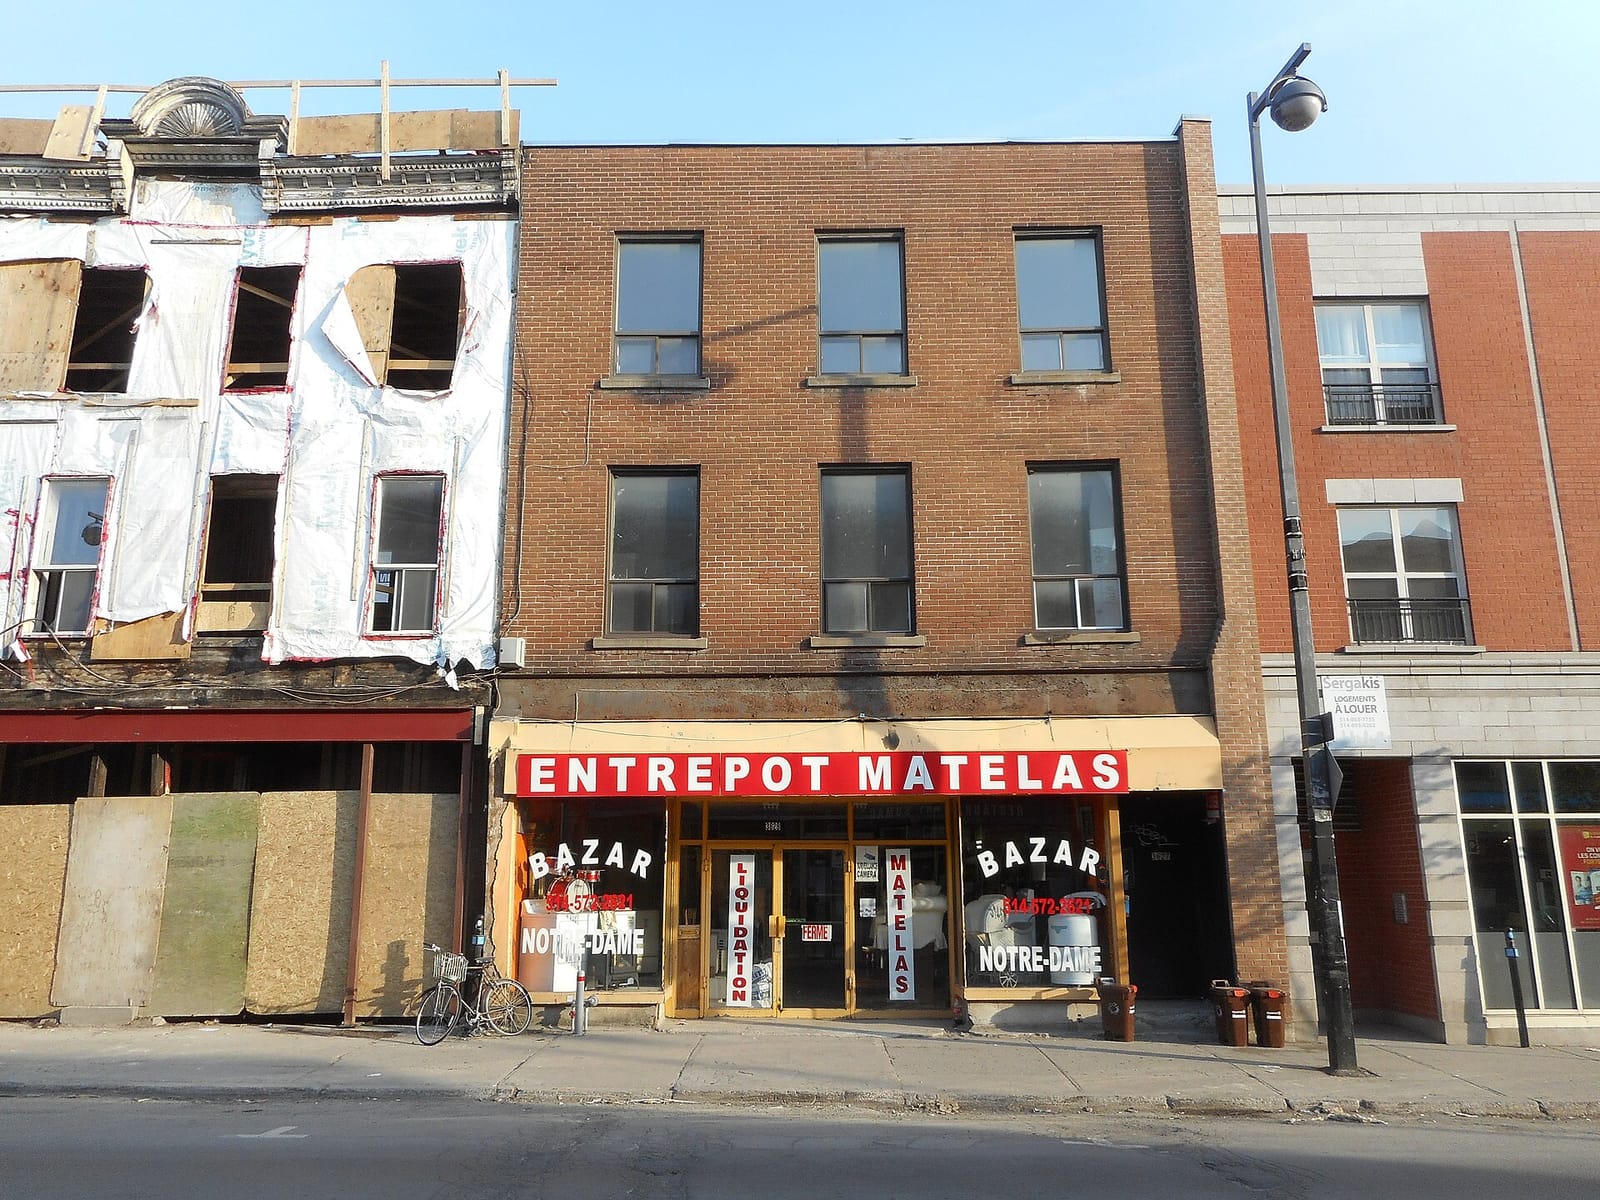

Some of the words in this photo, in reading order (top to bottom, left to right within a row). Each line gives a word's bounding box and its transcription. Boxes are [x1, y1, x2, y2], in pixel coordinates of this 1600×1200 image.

[1323, 676, 1380, 691] Sergakis
[1344, 705, 1377, 713] LOUER
[529, 756, 830, 793] ENTREPOT
[858, 753, 1121, 792] MATELAS
[528, 838, 652, 880] BAZAR
[977, 837, 1100, 879] BAZAR
[521, 928, 645, 955] NOTRE-DAME
[730, 862, 750, 1002] LIQUIDATION
[890, 854, 909, 993] MATELAS
[980, 946, 1102, 972] NOTRE-DAME
